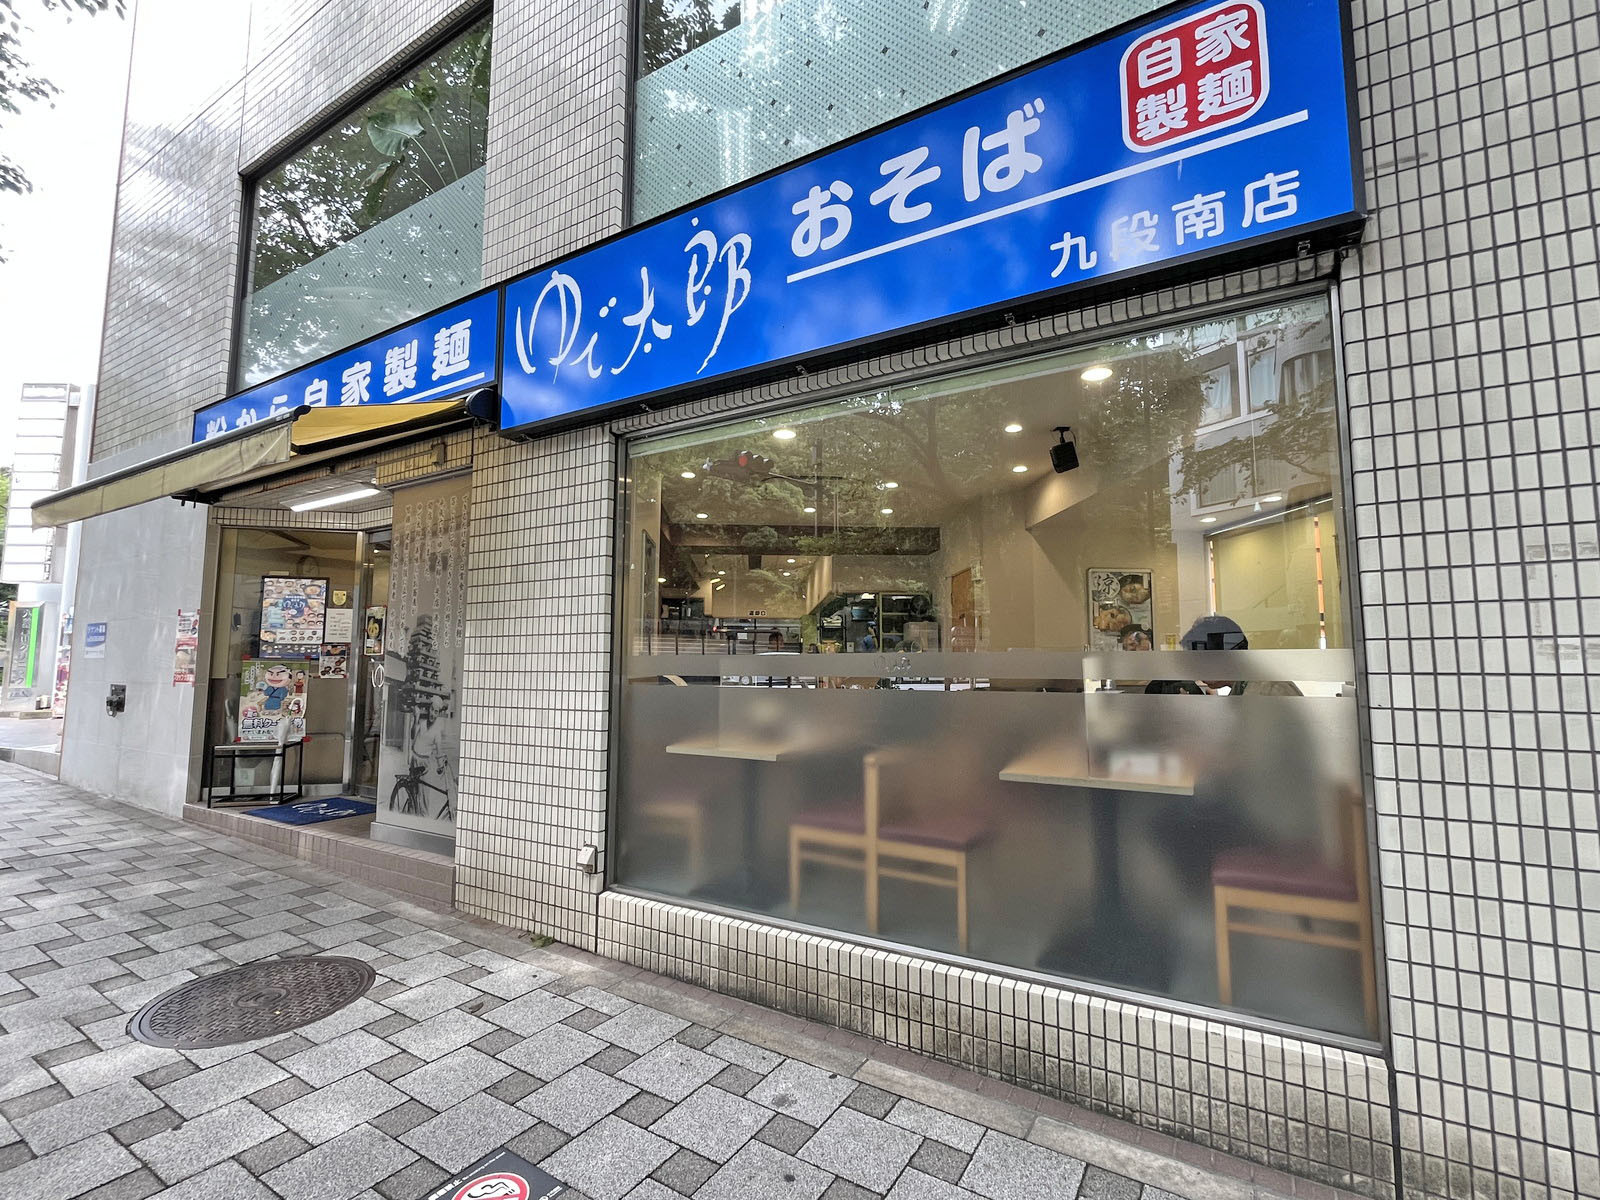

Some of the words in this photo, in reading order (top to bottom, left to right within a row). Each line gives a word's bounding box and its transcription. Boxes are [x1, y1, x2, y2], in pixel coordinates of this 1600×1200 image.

[1136, 60, 1255, 141] 製麺
[1137, 9, 1251, 89] 自家
[791, 97, 1045, 258] おそば
[1050, 170, 1300, 278] 九段南店
[516, 217, 752, 384] ゆで太郎
